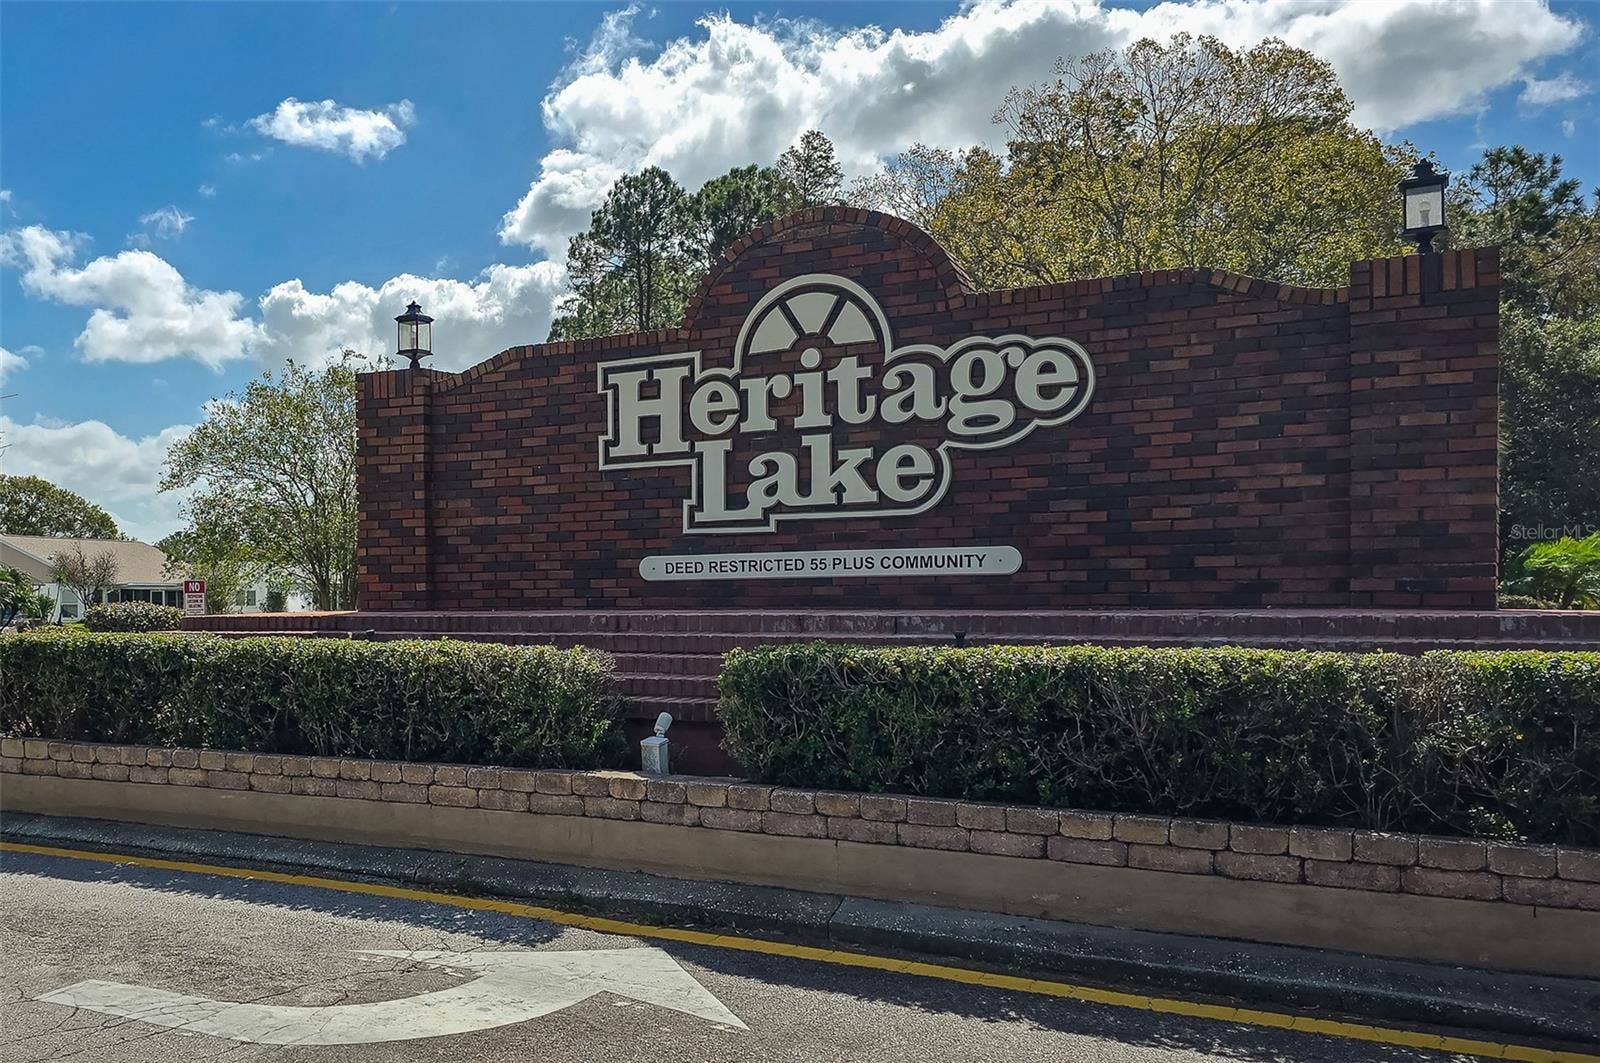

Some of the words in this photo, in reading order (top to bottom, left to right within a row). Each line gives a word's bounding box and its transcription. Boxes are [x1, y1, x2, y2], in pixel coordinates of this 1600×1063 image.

[608, 345, 1079, 458] Heritage
[694, 433, 935, 522] Lake
[188, 582, 201, 592] NO
[665, 561, 704, 574] DEED
[708, 558, 805, 573] RESTRICTED
[832, 557, 875, 570] PLUS
[880, 554, 987, 569] COMMUNITY
